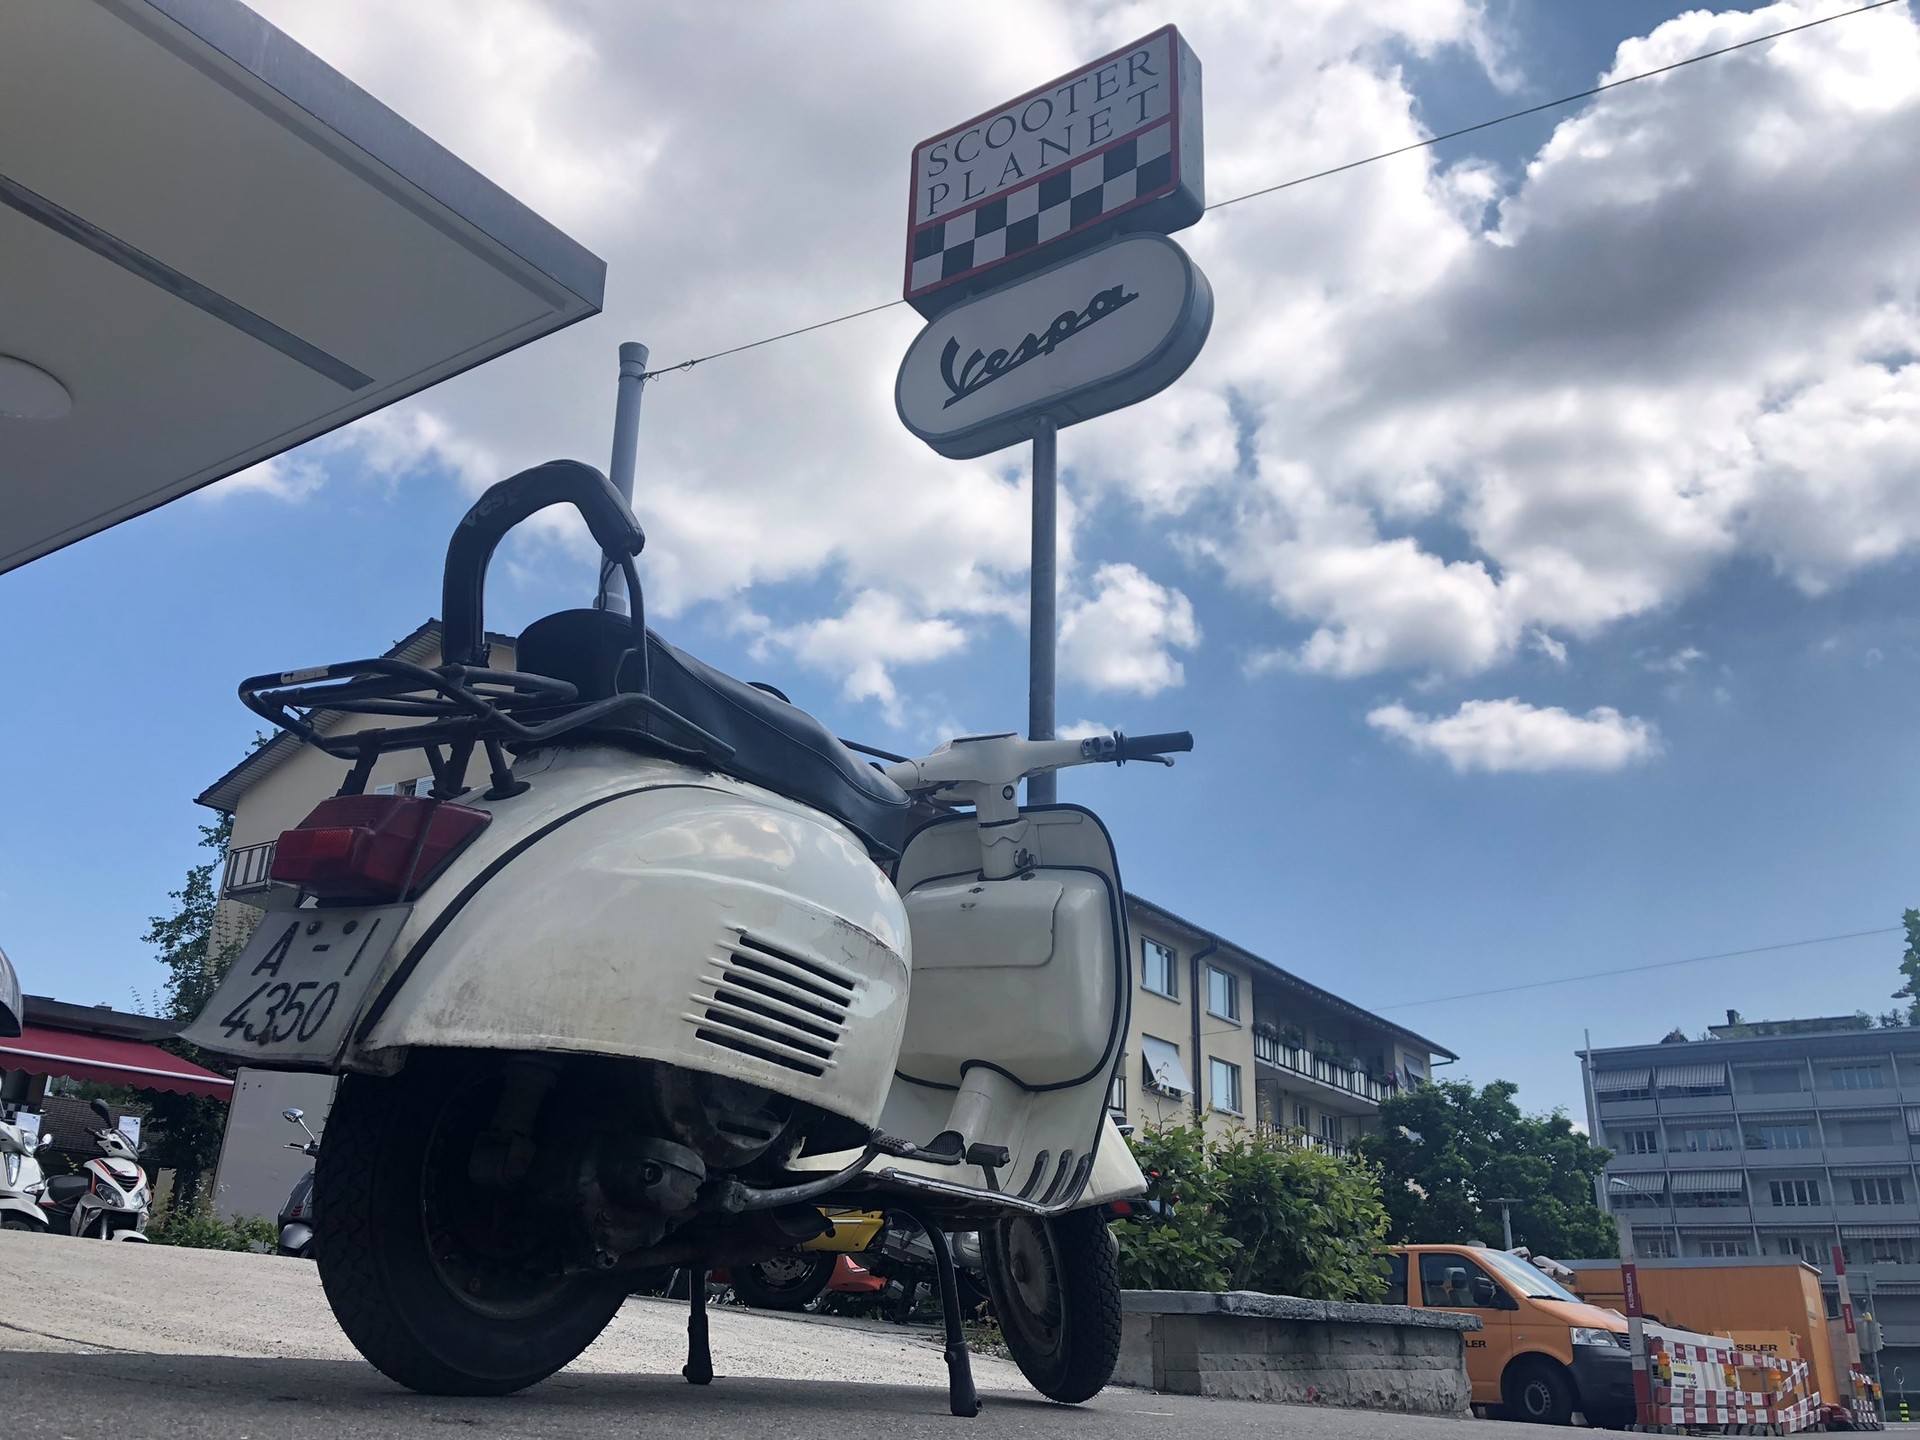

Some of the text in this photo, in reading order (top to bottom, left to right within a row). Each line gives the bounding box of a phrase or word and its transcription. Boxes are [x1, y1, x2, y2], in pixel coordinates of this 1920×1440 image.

[927, 84, 1159, 216] PLANET
[928, 50, 1159, 178] SCOOTER
[940, 284, 1139, 409] Vespa
[220, 981, 340, 1044] 4350
